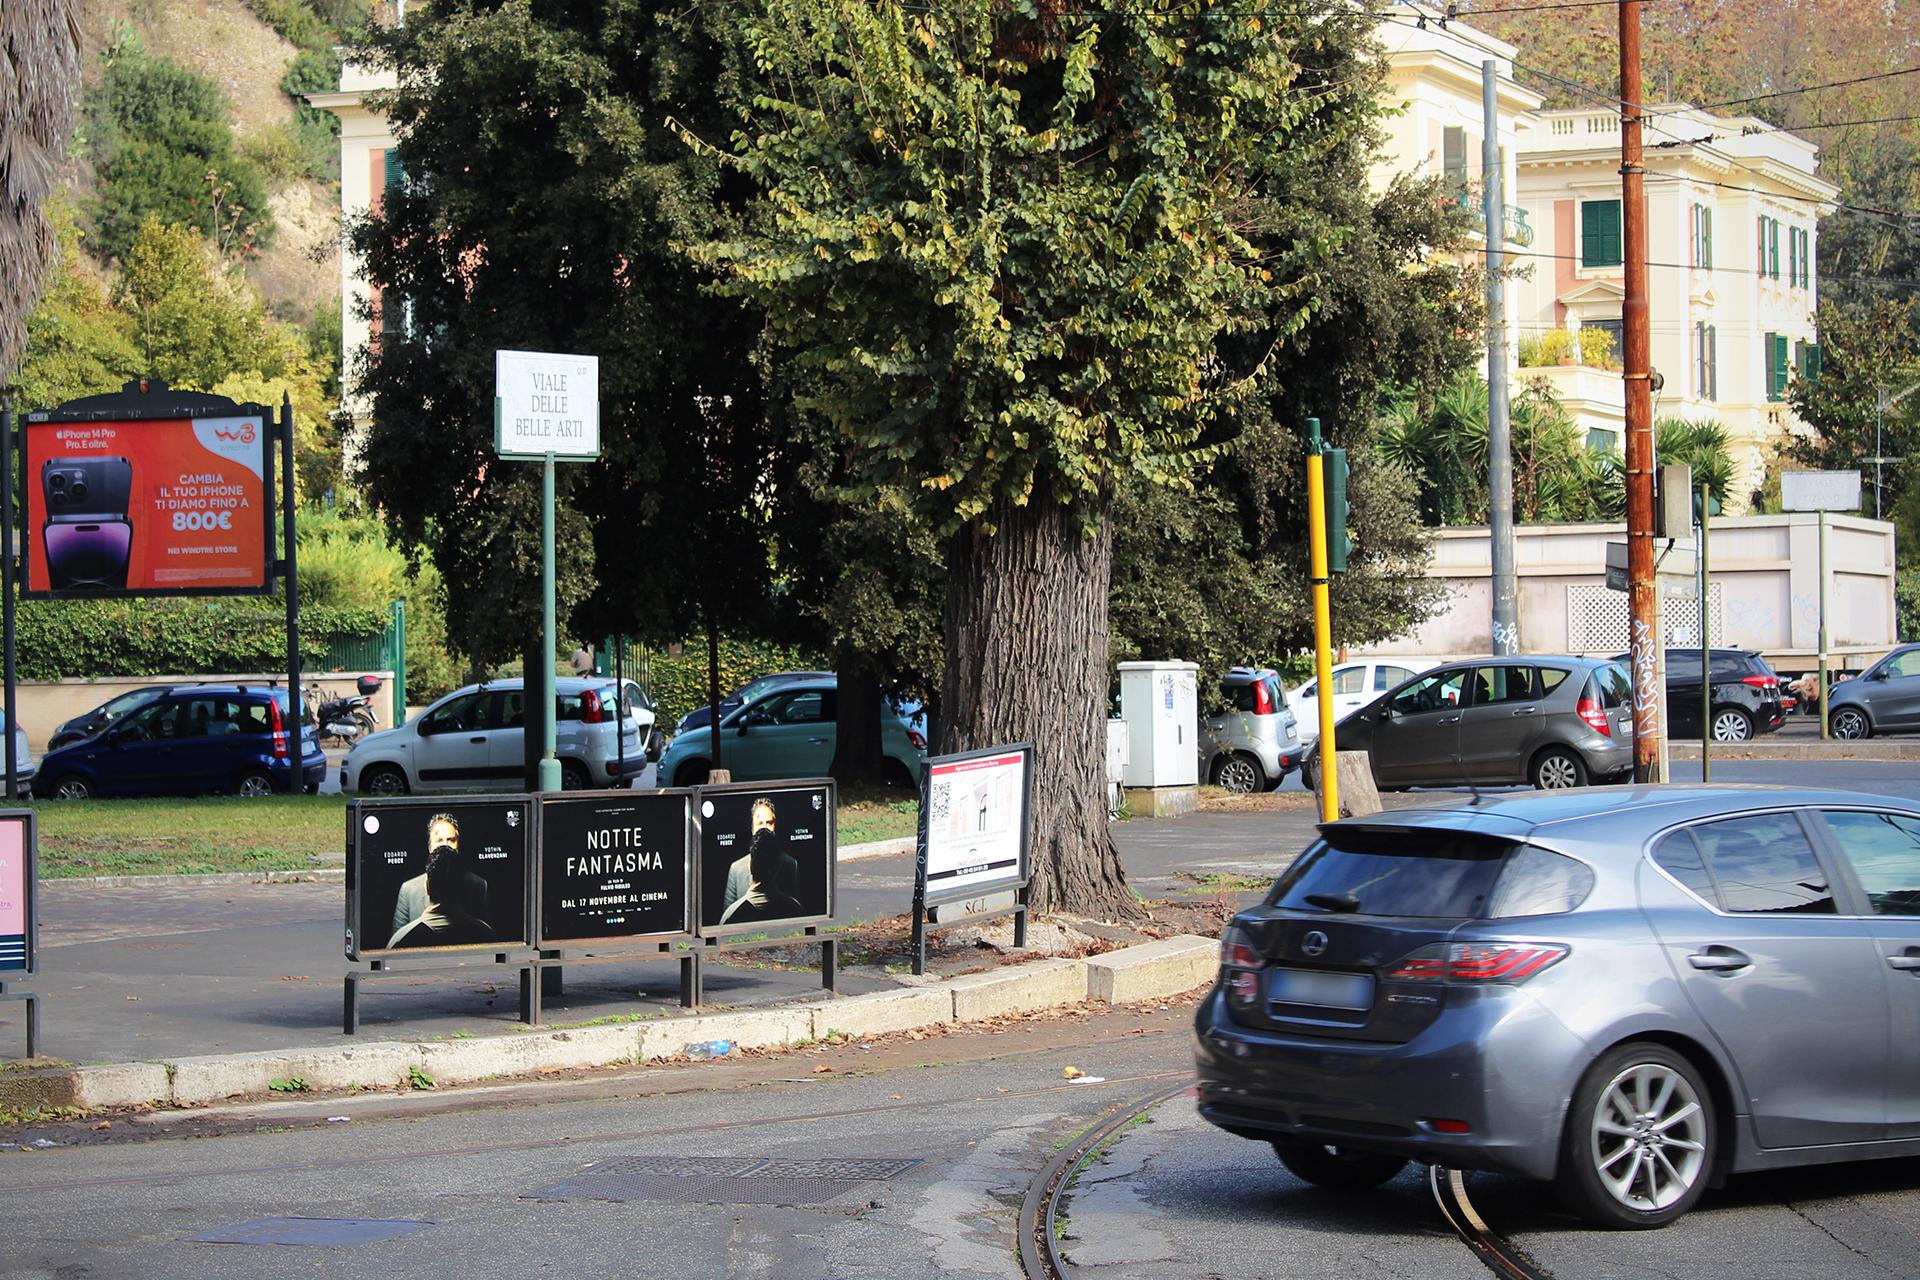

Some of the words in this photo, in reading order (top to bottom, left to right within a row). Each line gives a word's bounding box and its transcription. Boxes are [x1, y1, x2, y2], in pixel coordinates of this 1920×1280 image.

[532, 373, 567, 391] VIALE
[532, 395, 568, 414] DELLE
[63, 430, 91, 439] iPhone
[91, 429, 100, 438] 14
[101, 429, 116, 439] Pro
[515, 418, 551, 436] BELLE
[556, 420, 583, 437] ARTI
[66, 440, 81, 449] Pro.
[82, 440, 88, 449] E
[179, 474, 224, 485] CAMBIA
[160, 488, 170, 498] IL
[173, 487, 197, 497] TUO
[200, 485, 244, 496] IPHONE
[155, 500, 166, 510] TI
[168, 499, 207, 510] DIAMO
[209, 498, 238, 508] FINO
[240, 498, 249, 508] A
[172, 510, 233, 532] 800€
[587, 827, 642, 850] NOTTE
[567, 851, 663, 877] FANTASMA
[561, 900, 576, 908] DAL
[579, 898, 587, 907] 17
[589, 895, 627, 906] NOVEMBRE
[629, 894, 639, 903] AL
[641, 892, 668, 902] CINEMA
